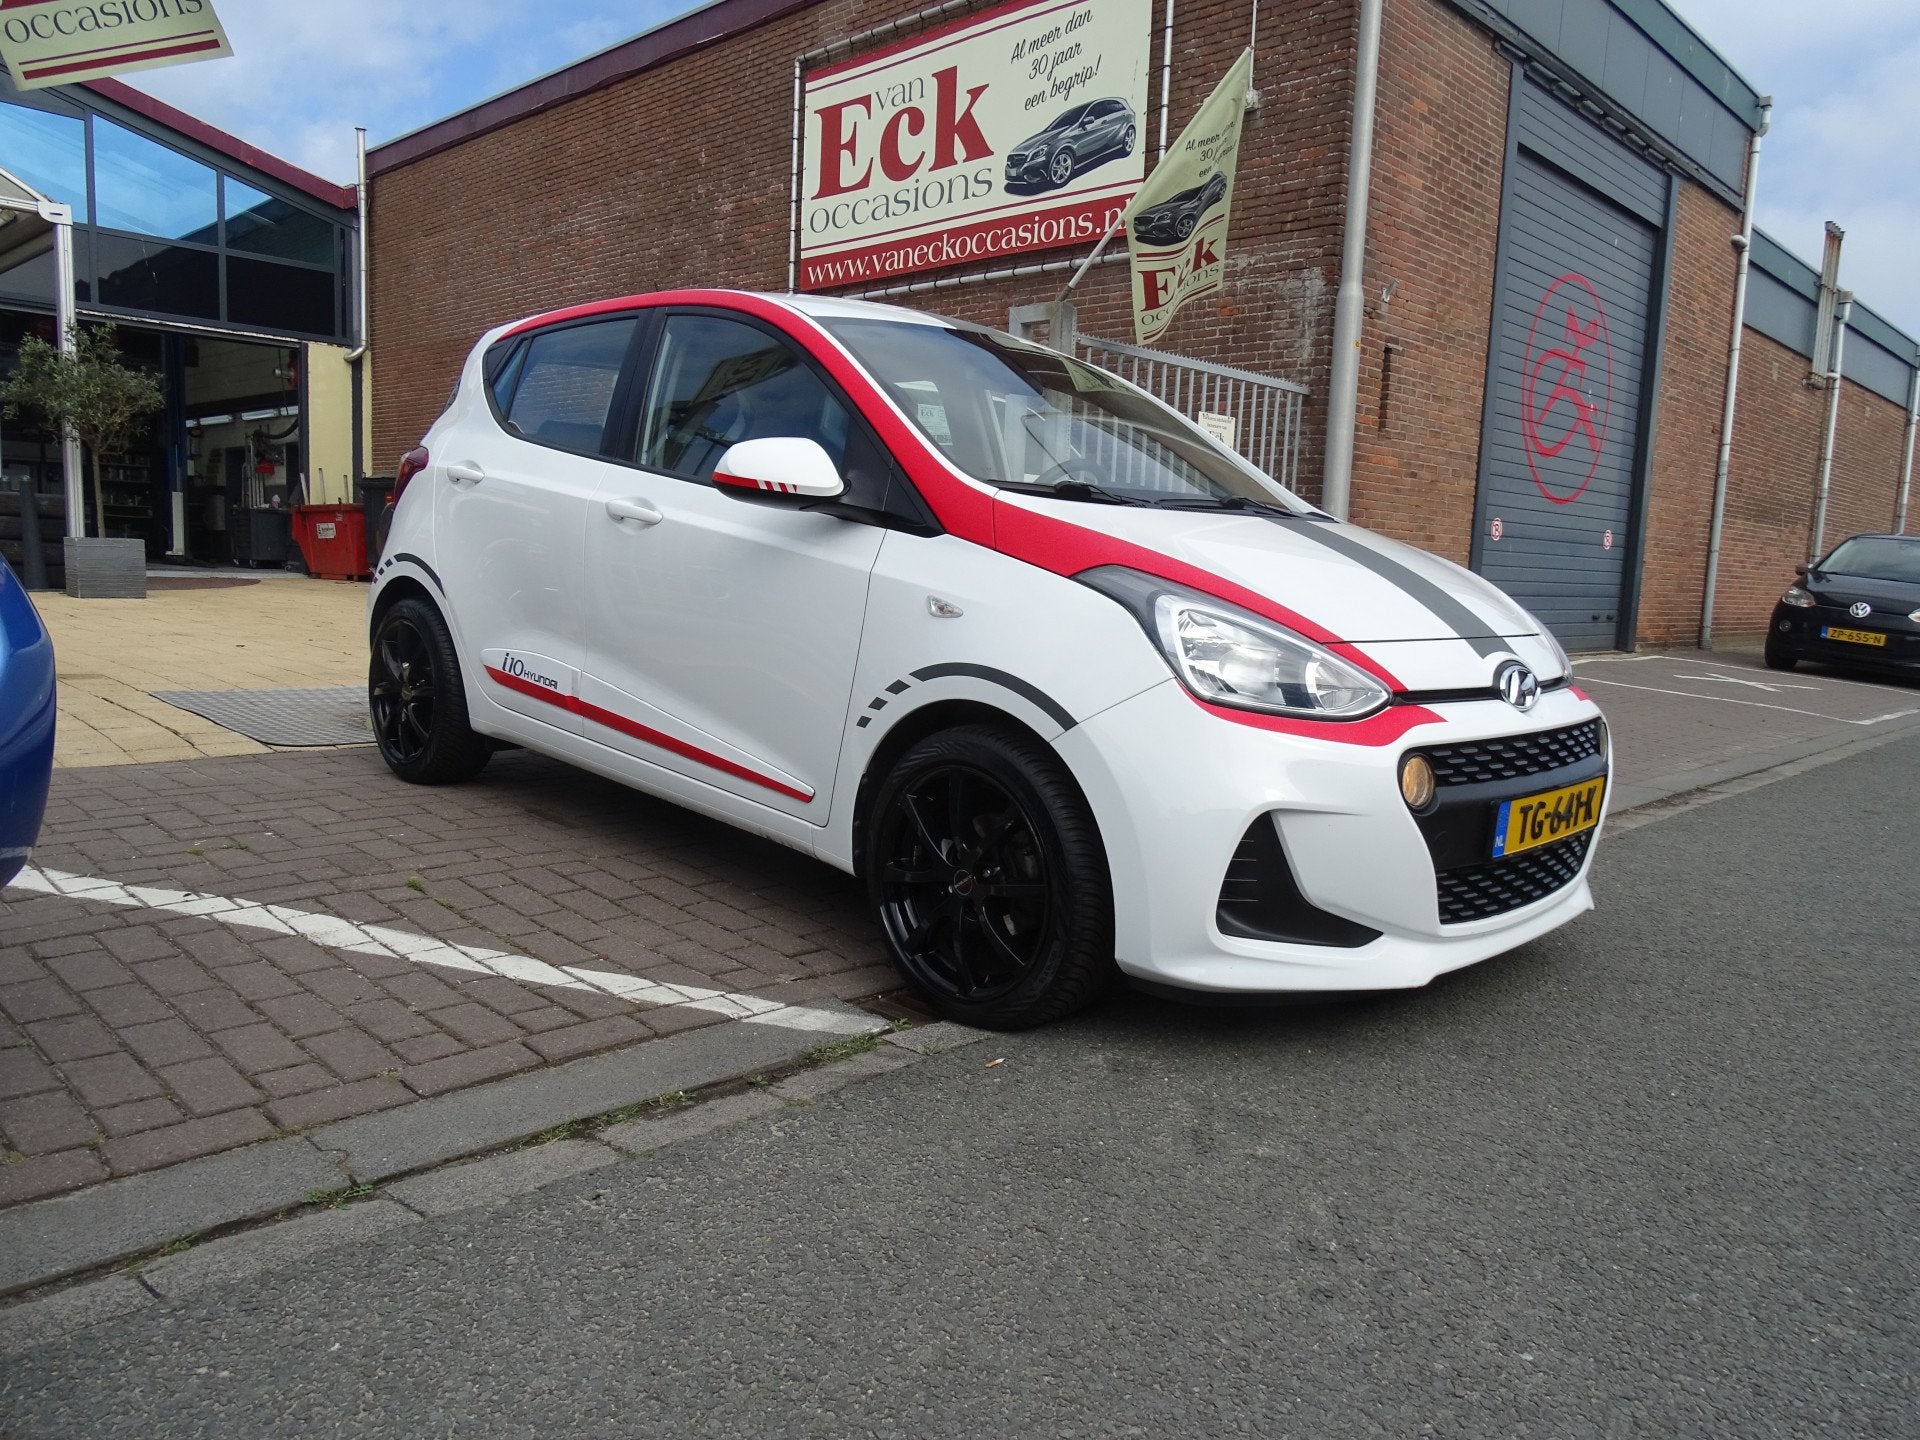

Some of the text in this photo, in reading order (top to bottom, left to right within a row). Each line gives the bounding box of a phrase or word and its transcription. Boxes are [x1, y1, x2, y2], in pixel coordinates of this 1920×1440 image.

[4, 0, 203, 43] occasions
[1010, 9, 1093, 64] Al meer dan
[1028, 42, 1083, 82] 30 jaar
[875, 76, 925, 111] van
[1024, 54, 1102, 111] een begrip!
[811, 65, 994, 200] Eck
[1185, 139, 1196, 152] Al
[1199, 148, 1213, 162] 30
[809, 167, 994, 233] occasions
[1830, 629, 1882, 644] ZP-655-N
[502, 653, 558, 690] i10 HYUNDAI
